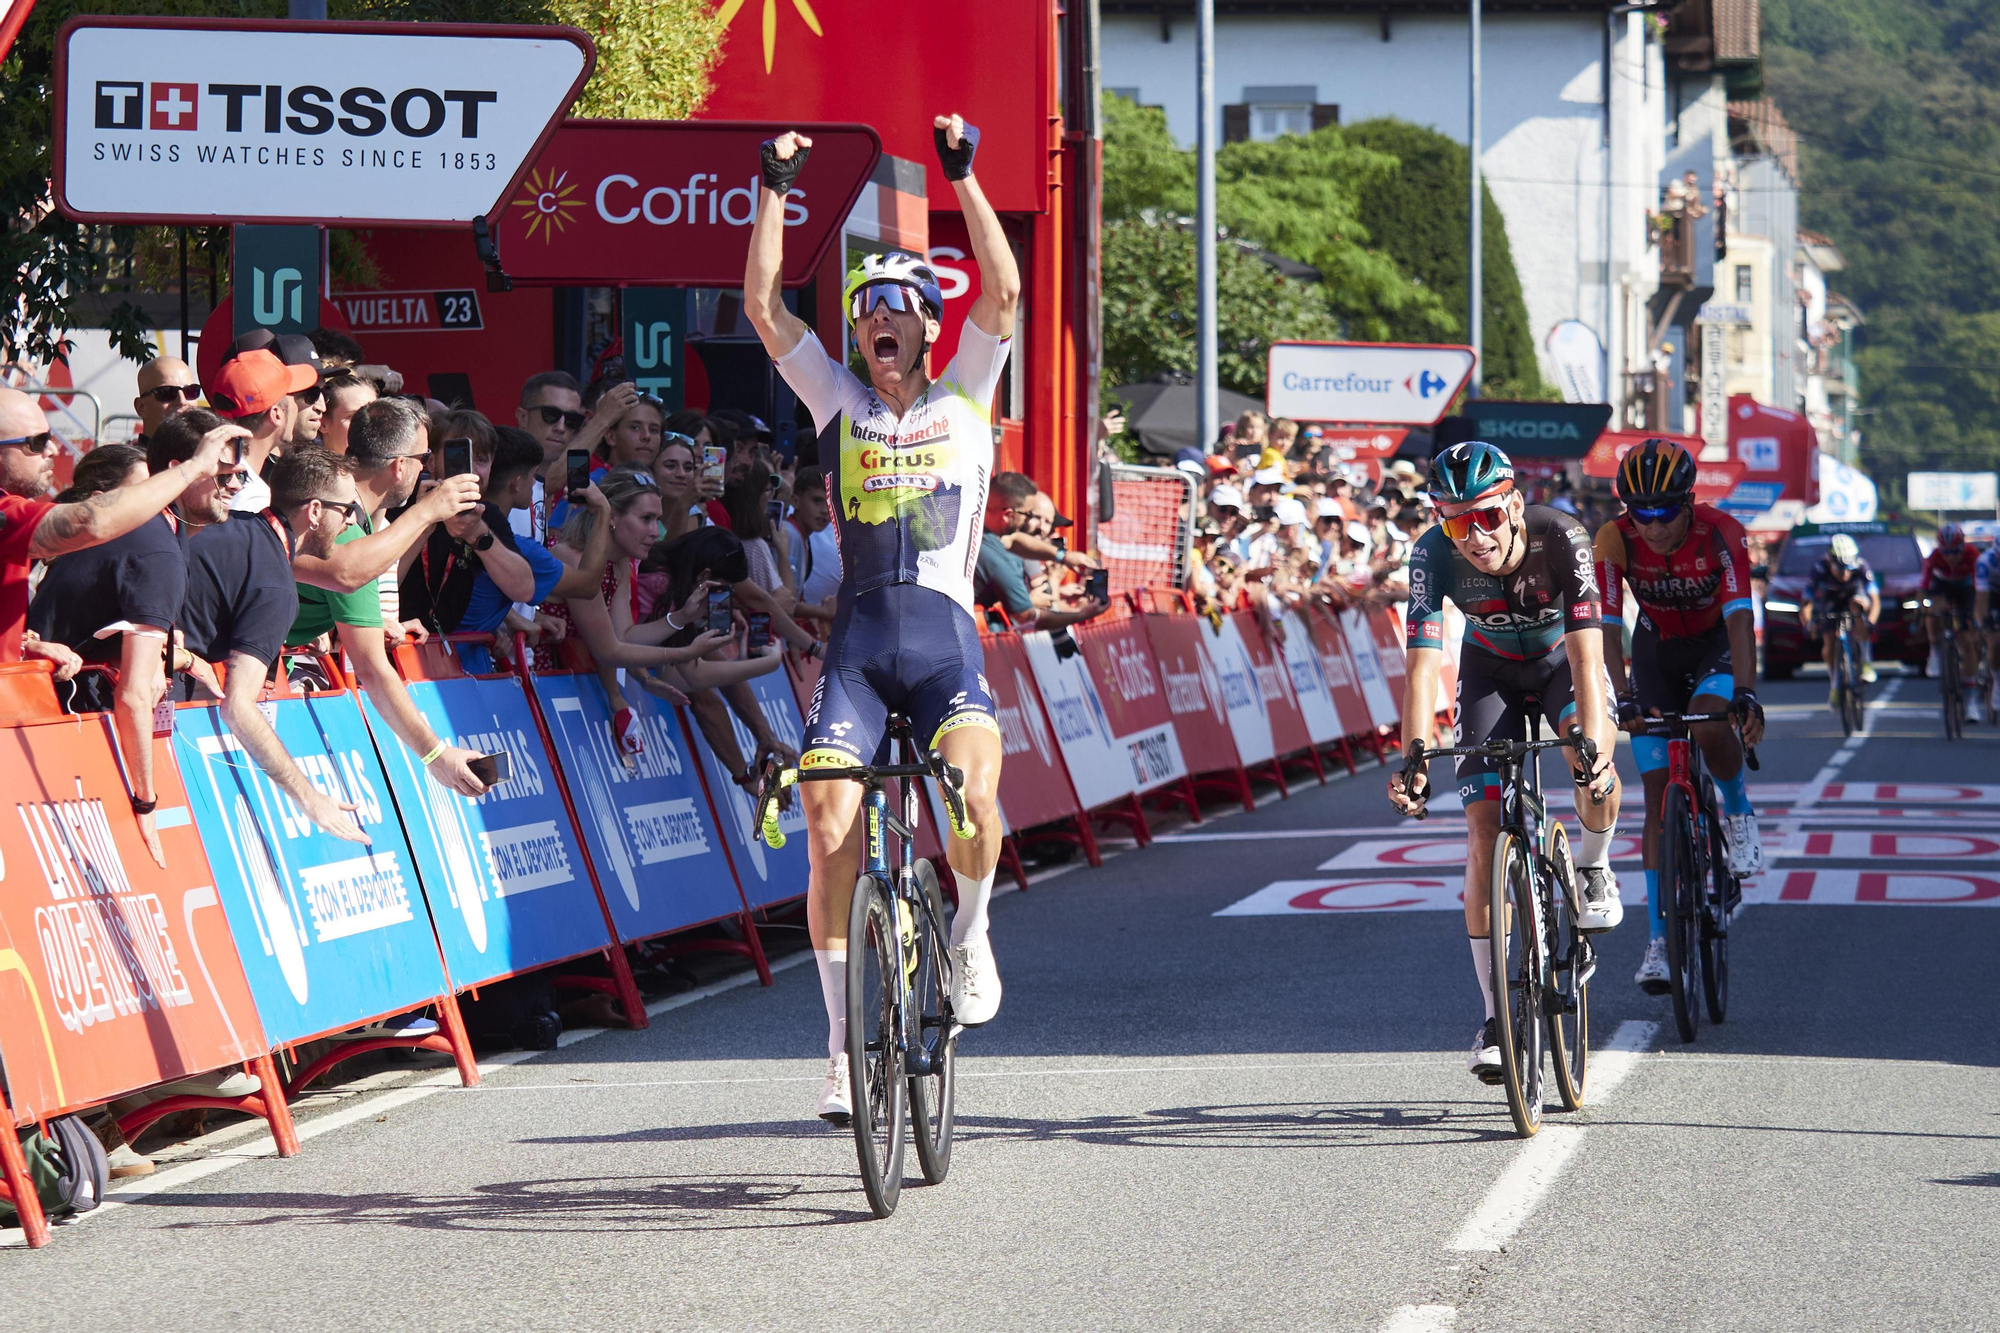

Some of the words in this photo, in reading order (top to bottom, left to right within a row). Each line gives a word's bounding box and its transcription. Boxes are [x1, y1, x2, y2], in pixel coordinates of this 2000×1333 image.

[208, 84, 497, 138] TISSOT
[94, 142, 180, 163] SWISS
[198, 145, 325, 167] WATCHES
[342, 149, 422, 169] SINCE
[440, 152, 497, 171] 1853
[595, 173, 809, 226] Cofids
[346, 298, 429, 325] VUELTA
[444, 297, 472, 323] 23
[1283, 372, 1392, 393] Carrefour
[851, 416, 949, 448] Intermarché
[860, 450, 936, 469] Circus
[870, 477, 930, 489] WANTY
[1462, 578, 1472, 588] LE
[1473, 578, 1494, 588] COL
[811, 737, 861, 755] CUBE
[635, 817, 660, 850] CON
[663, 811, 701, 845] DEPORTE
[869, 806, 878, 858] CUBE
[491, 845, 517, 881] CON
[522, 835, 565, 874] DEPORTE
[314, 880, 340, 923] CON
[352, 869, 402, 915] DEPORTE
